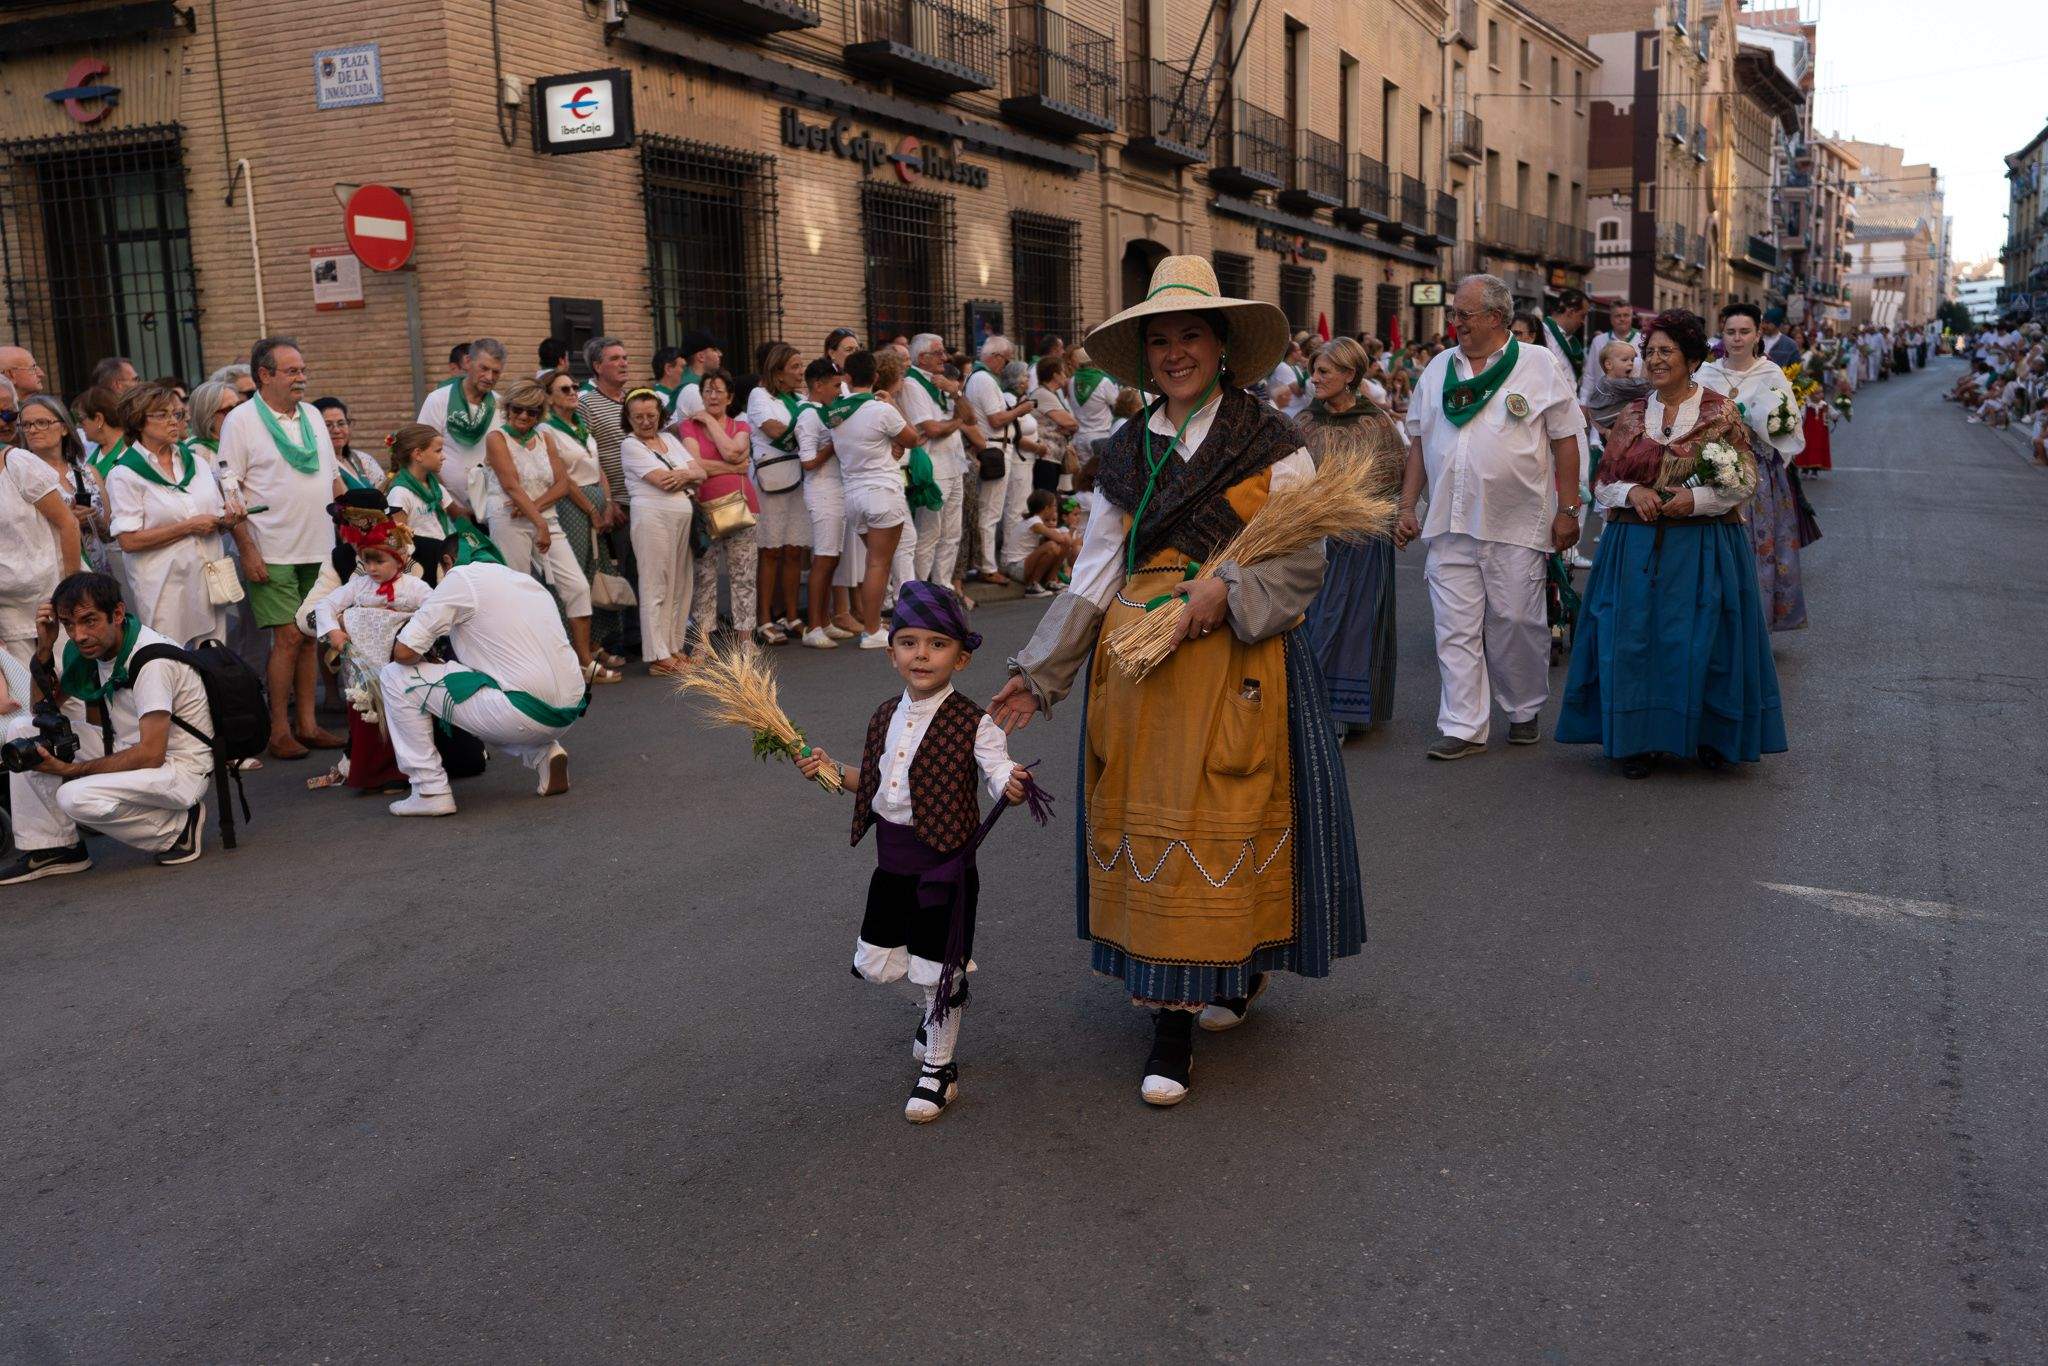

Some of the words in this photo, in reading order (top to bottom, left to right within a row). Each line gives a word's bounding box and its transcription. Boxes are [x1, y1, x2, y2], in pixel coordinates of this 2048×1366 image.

[340, 55, 369, 68] PLAZA
[338, 70, 352, 84] DE
[355, 69, 368, 82] LA
[325, 83, 374, 100] INMACULADA
[561, 123, 601, 135] iberCaja
[780, 107, 887, 175] iberCaja
